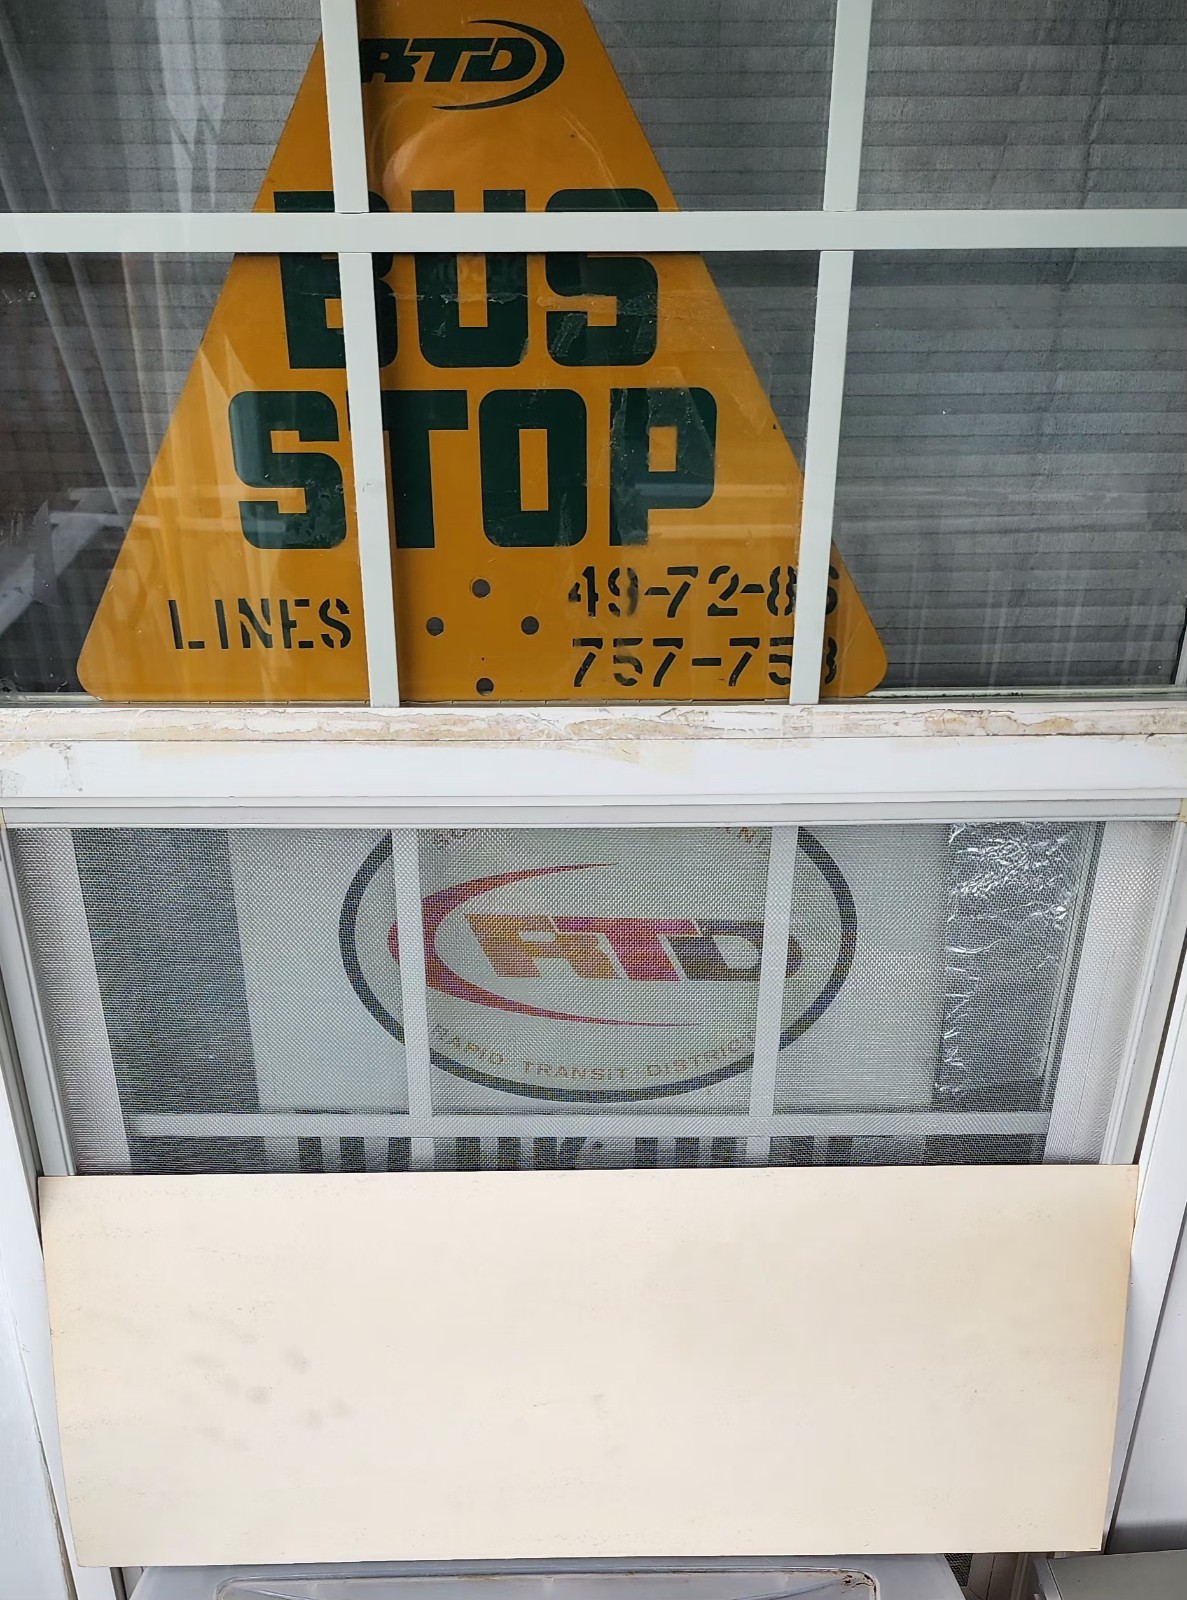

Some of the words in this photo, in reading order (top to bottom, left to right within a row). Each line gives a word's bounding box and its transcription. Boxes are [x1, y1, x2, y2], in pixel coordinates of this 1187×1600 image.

[359, 37, 537, 82] RTD
[273, 188, 659, 370] BUS
[227, 386, 717, 549] STOP
[167, 597, 352, 650] LINES
[431, 1023, 505, 1066] RAPID
[522, 1059, 629, 1081] TRANSIT
